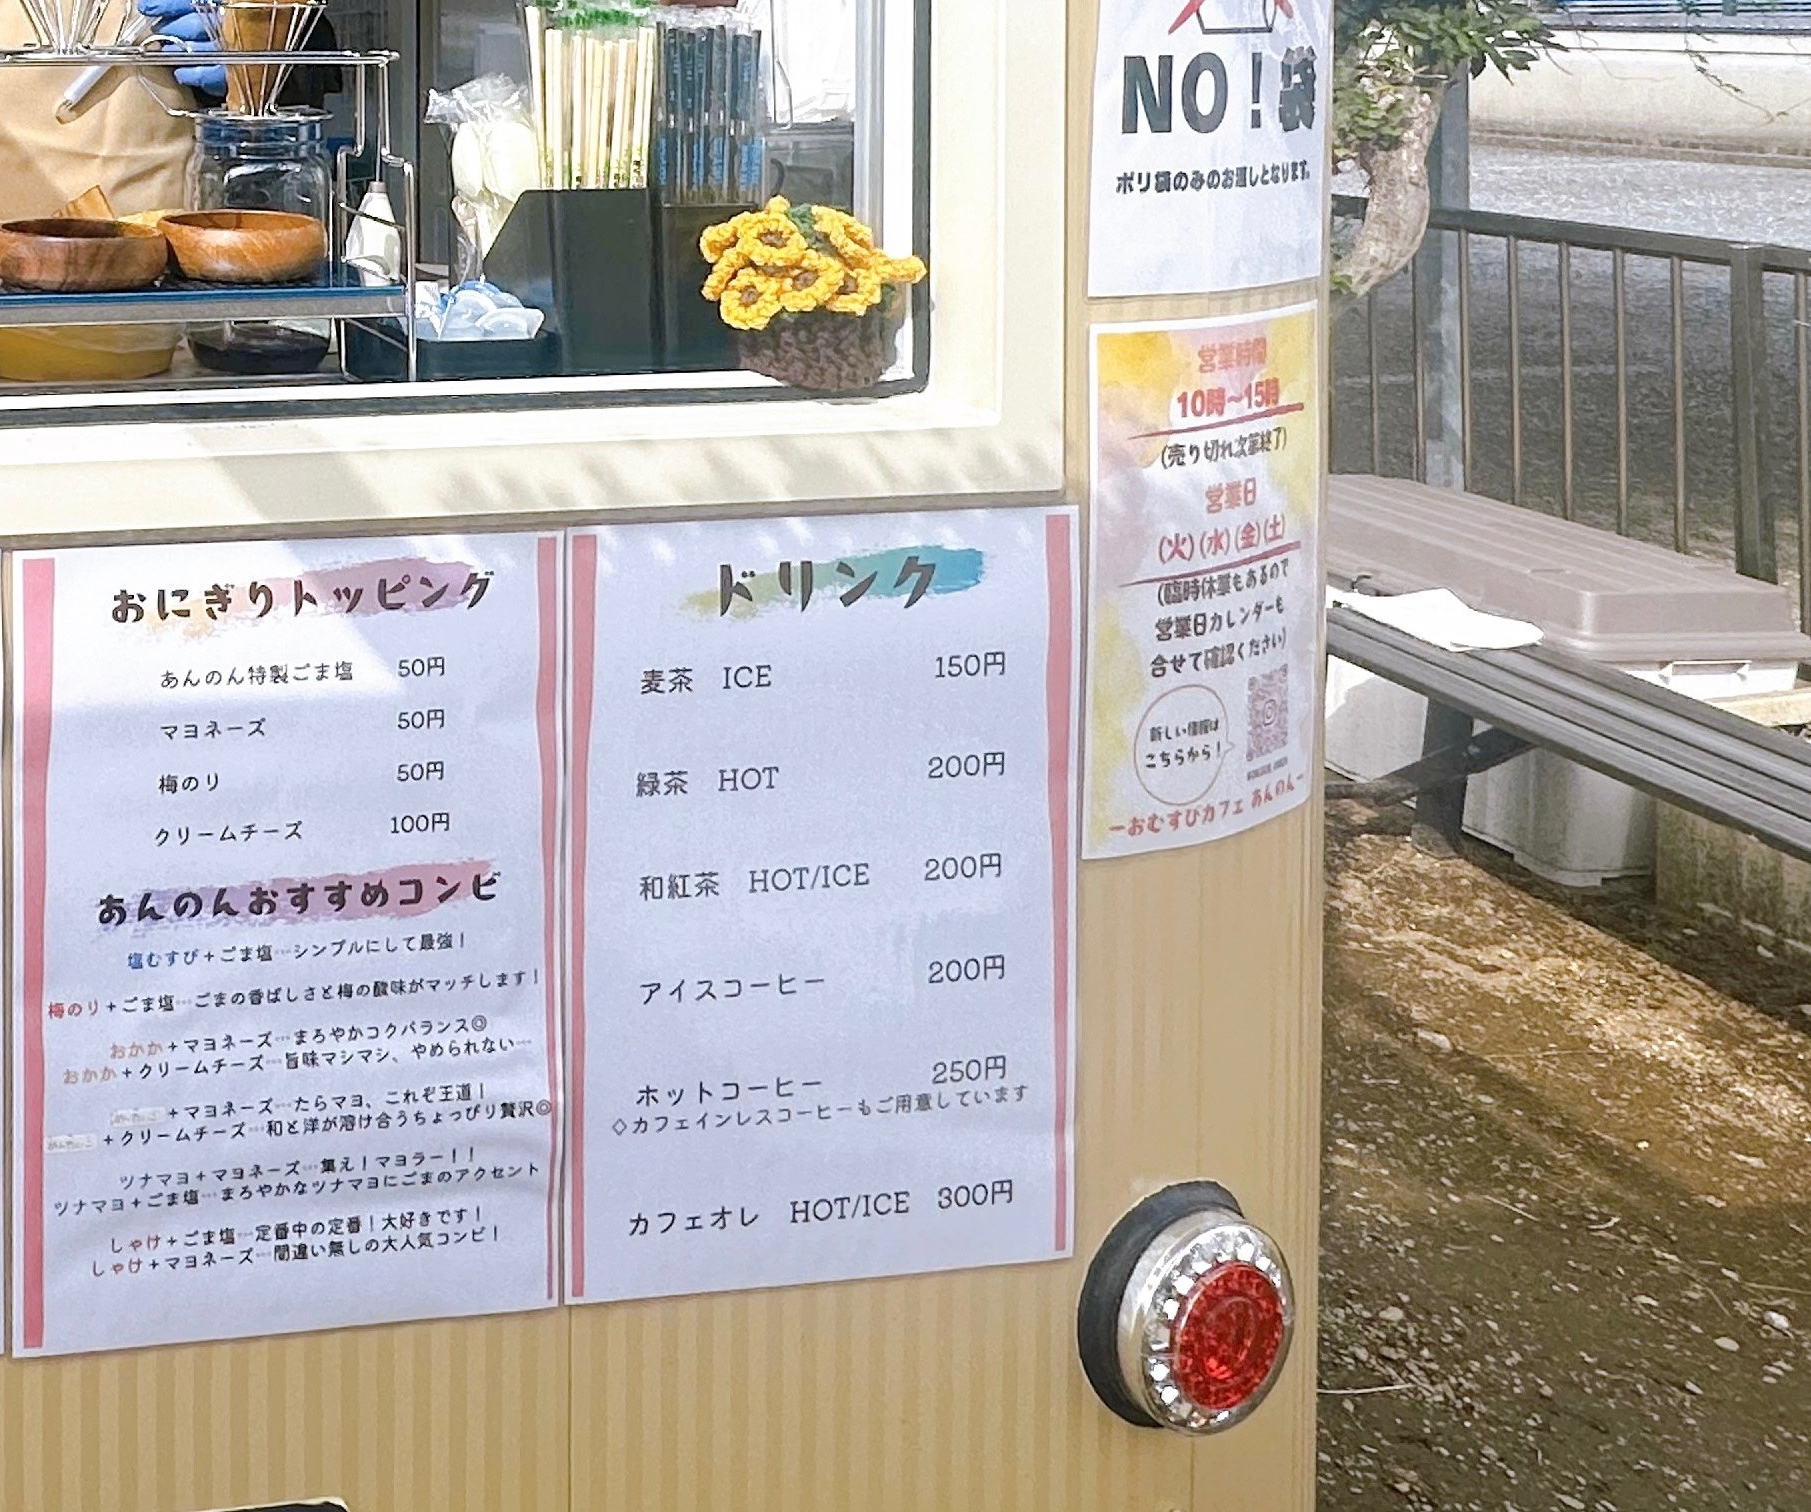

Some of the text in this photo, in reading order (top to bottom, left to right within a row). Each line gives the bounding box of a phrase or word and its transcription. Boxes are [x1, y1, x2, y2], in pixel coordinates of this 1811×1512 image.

[1197, 337, 1268, 374] 営業時間
[1205, 477, 1257, 515] 営業日
[111, 570, 496, 624] おにぎりトッピング
[719, 555, 937, 617] ドリンク
[1154, 595, 1285, 642] 営業日カレンダーも
[160, 656, 446, 690] あんのん特製ごま塩 50円
[640, 650, 1007, 696] 麦茶 ICE 150円
[159, 708, 446, 740] マヨネーズ 50円
[158, 761, 445, 794] 梅のり 50円
[635, 751, 1007, 798] 緑茶 HOT 200円
[154, 812, 451, 847] クリームチーズ 100円
[98, 871, 503, 926] あんのんおすすめコンビ
[639, 852, 1003, 902] 和紅茶 HOT/ICE 200円
[639, 953, 1007, 1005] アイスコーヒー 200円
[635, 1054, 1008, 1107] ホットコーヒー 250円
[628, 1179, 1015, 1237] カフェオレ HOT/ICE 300円
